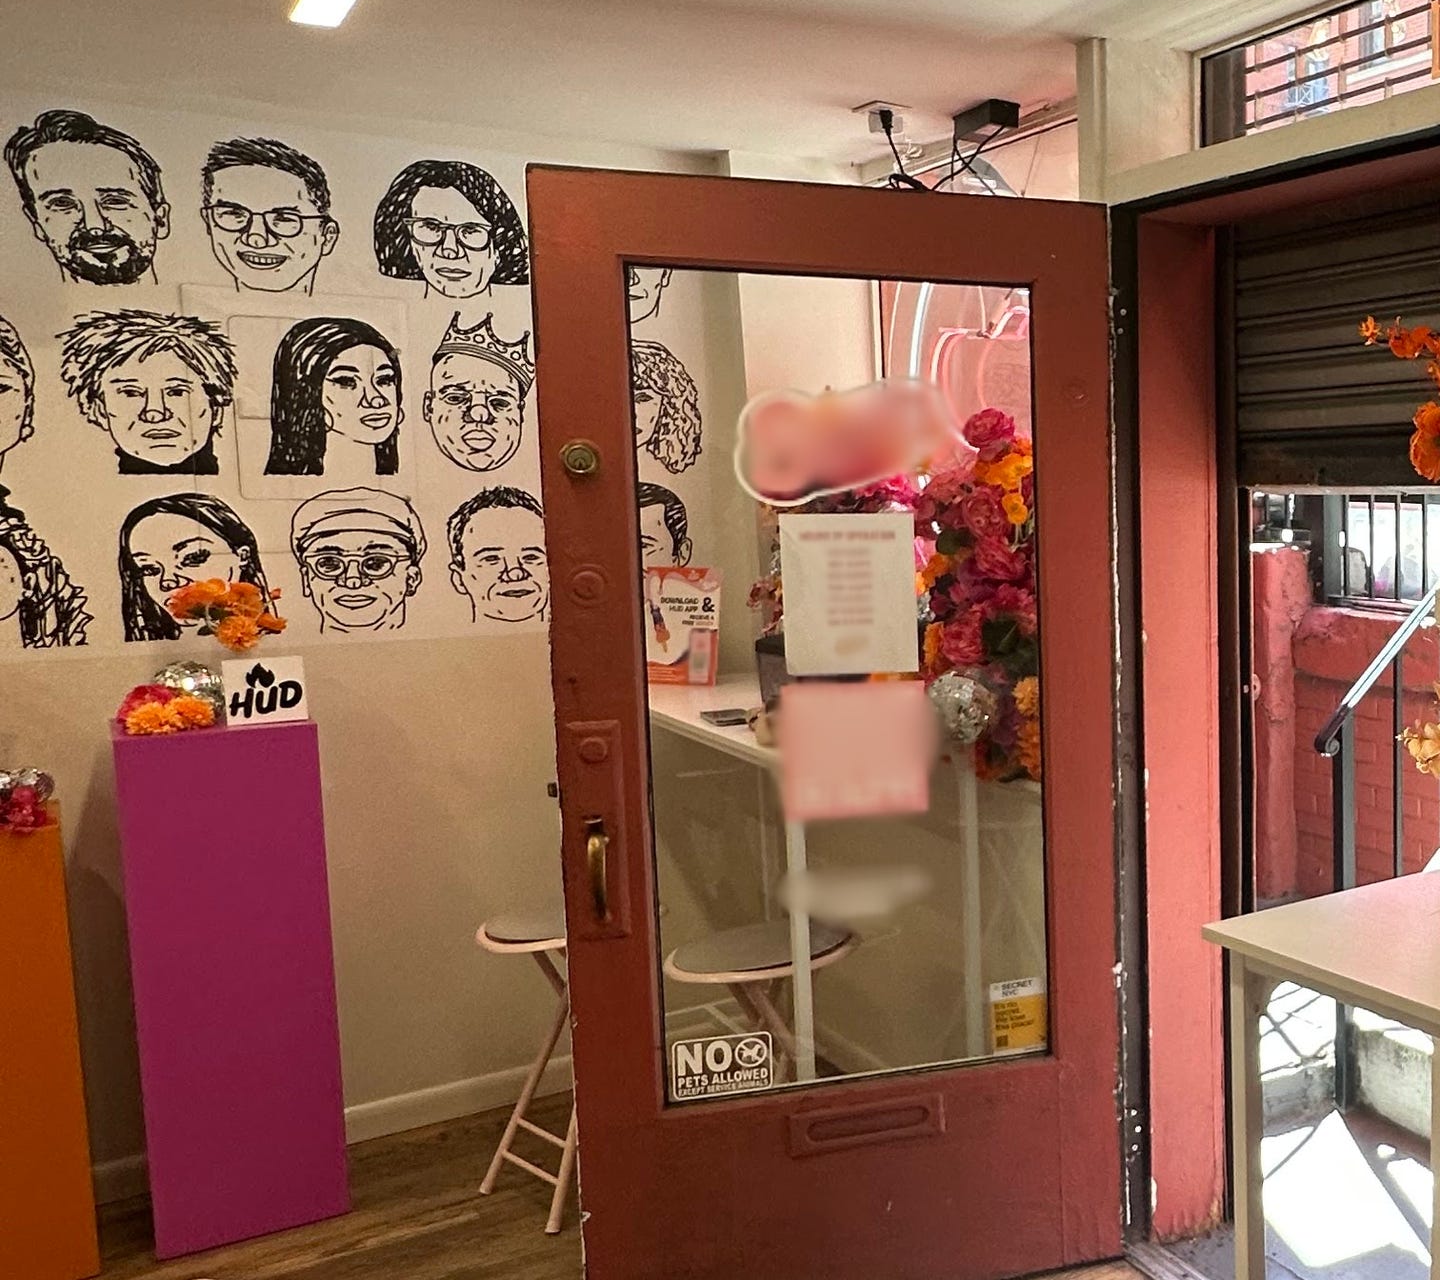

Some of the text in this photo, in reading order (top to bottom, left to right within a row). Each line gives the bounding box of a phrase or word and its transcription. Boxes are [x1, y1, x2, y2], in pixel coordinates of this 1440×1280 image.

[701, 597, 715, 613] &
[229, 680, 303, 718] HUD
[1002, 979, 1033, 991] SECRET
[1002, 989, 1017, 998] NYC
[676, 1040, 733, 1076] NO
[678, 1067, 769, 1089] PETS ALLOWED
[678, 1078, 769, 1097] EXCEPT SERVICE ANIMALS
